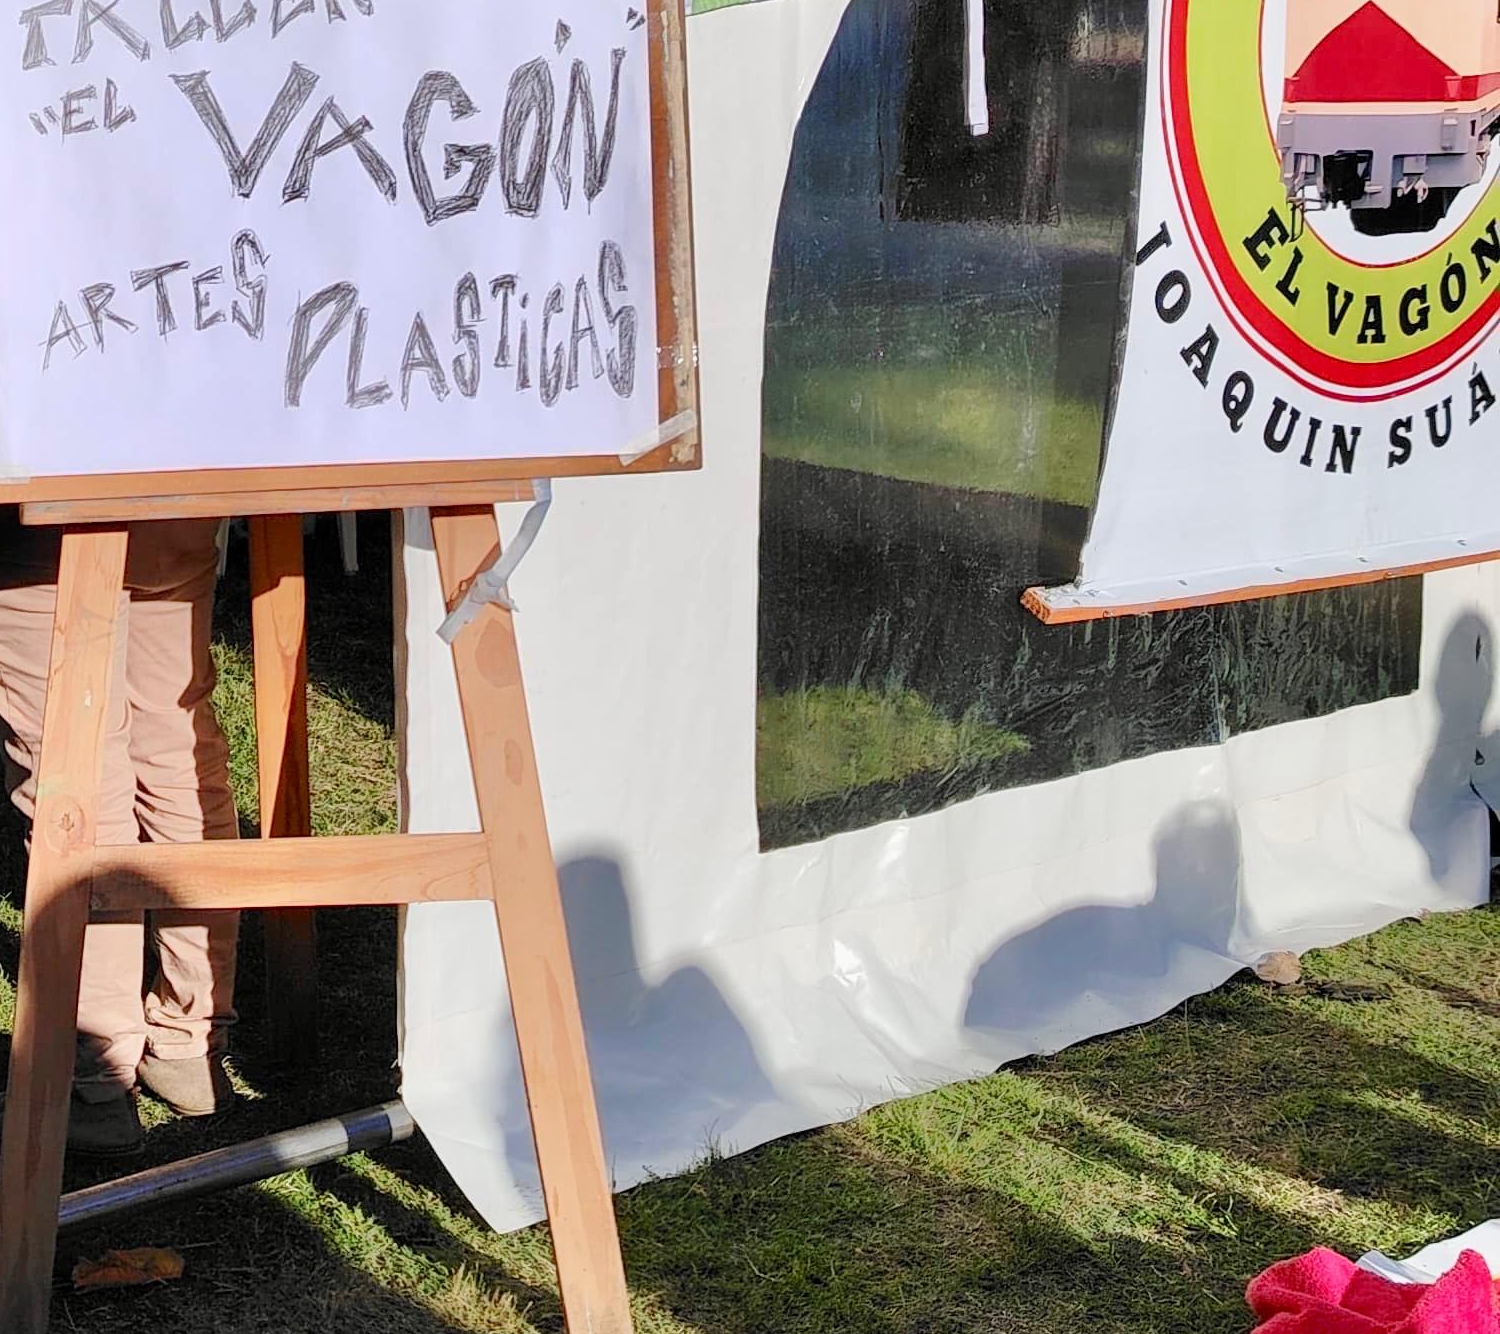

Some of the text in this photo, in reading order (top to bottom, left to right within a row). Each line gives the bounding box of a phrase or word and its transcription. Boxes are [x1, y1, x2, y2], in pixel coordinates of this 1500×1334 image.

[38, 228, 271, 374] ARTES
[1135, 220, 1500, 475] JOAQUIN SUÁ
[1242, 206, 1500, 345] EL VAGÓN
